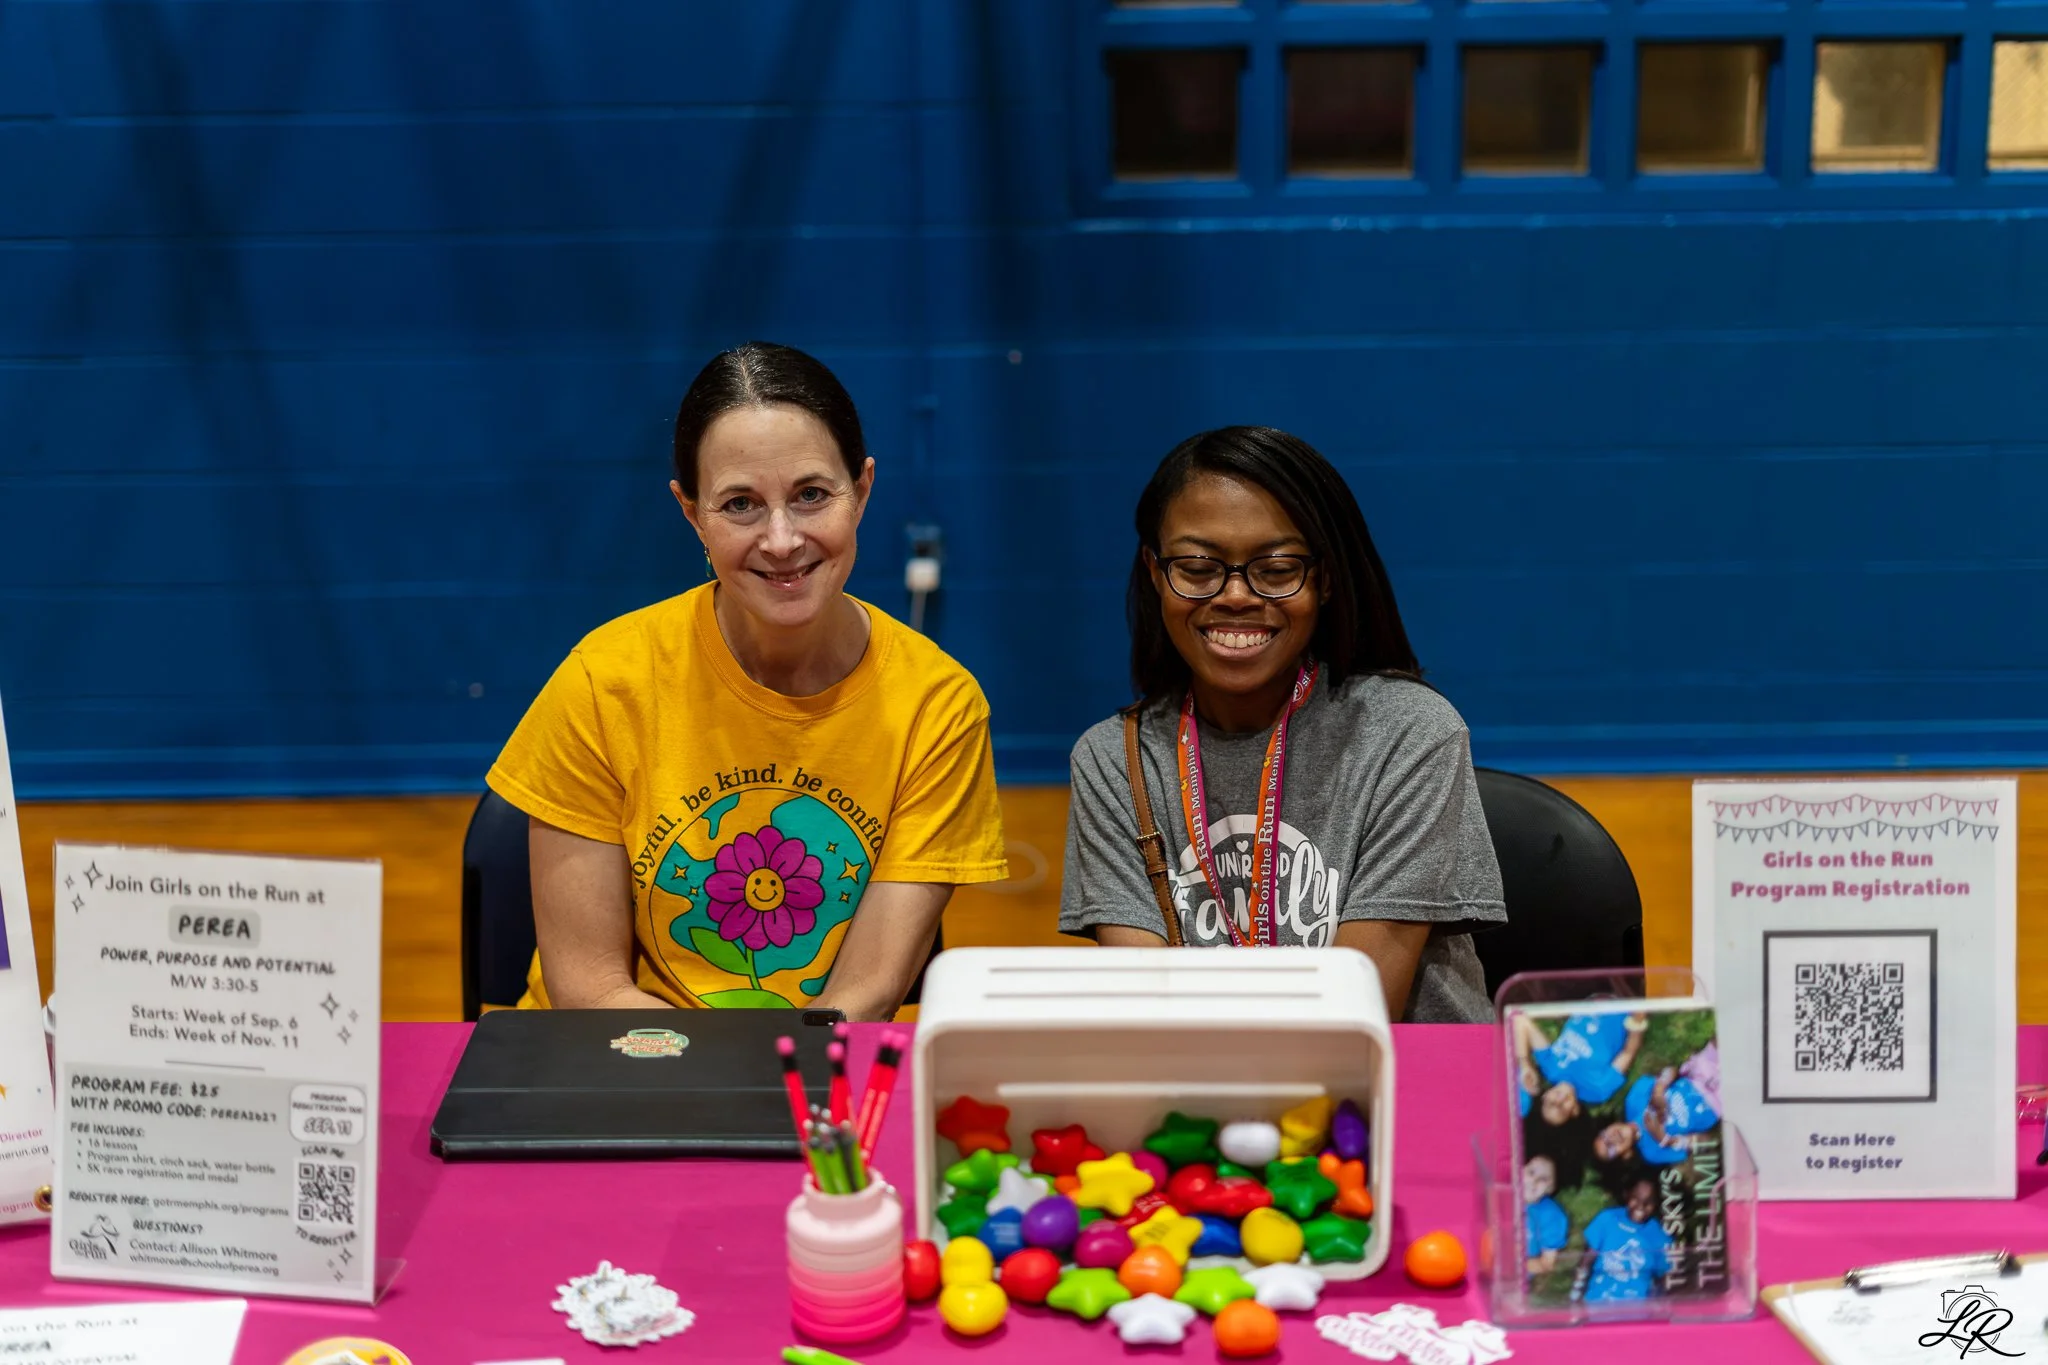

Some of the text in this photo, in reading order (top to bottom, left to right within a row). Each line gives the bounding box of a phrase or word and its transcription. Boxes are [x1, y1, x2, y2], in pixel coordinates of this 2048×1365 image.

[681, 785, 712, 812] be
[715, 763, 784, 792] kind.
[792, 768, 823, 792] be
[1186, 744, 1202, 811] Memphis
[1192, 812, 1210, 860] Run
[1254, 723, 1284, 947] irls on the Run Memphis
[1763, 850, 1934, 868] Girls on the Run
[105, 874, 325, 905] Join Girls on the Run at
[1730, 878, 1971, 902] Program Registration
[178, 914, 251, 939] PEREA
[100, 947, 336, 975] POWER, PURPOSE AND POTENTIAL
[170, 974, 259, 992] M/W 3:30-5
[131, 1004, 298, 1031] Starts: Week of Sep. 6
[129, 1024, 300, 1050] Ends: Week of Nov. 11
[71, 1074, 220, 1098] PROGRAM FEE: $25
[70, 1096, 110, 1112] WITH
[113, 1098, 163, 1115] PROMO
[167, 1102, 207, 1118] CODE:
[70, 1121, 146, 1138] FEE INCLUDES:
[1809, 1132, 1896, 1147] Scan Here
[103, 1139, 139, 1151] lessons
[87, 1151, 130, 1167] Program
[160, 1156, 185, 1169] cinch
[215, 1162, 242, 1172] water
[245, 1162, 277, 1175] bottle
[1805, 1155, 1903, 1173] to Register
[102, 1166, 125, 1176] race
[126, 1167, 184, 1181] registration
[186, 1170, 206, 1182] and
[208, 1172, 239, 1185] medal
[68, 1190, 118, 1205] REGISTER
[120, 1194, 150, 1207] HERE:
[1693, 1138, 1725, 1288] THE LIMIT
[132, 1218, 203, 1235] QUESTIONS?
[1660, 1168, 1687, 1289] THE SKY'S
[129, 1239, 279, 1262] Contact: Allison Whitmore
[309, 1231, 357, 1247] REGISTER
